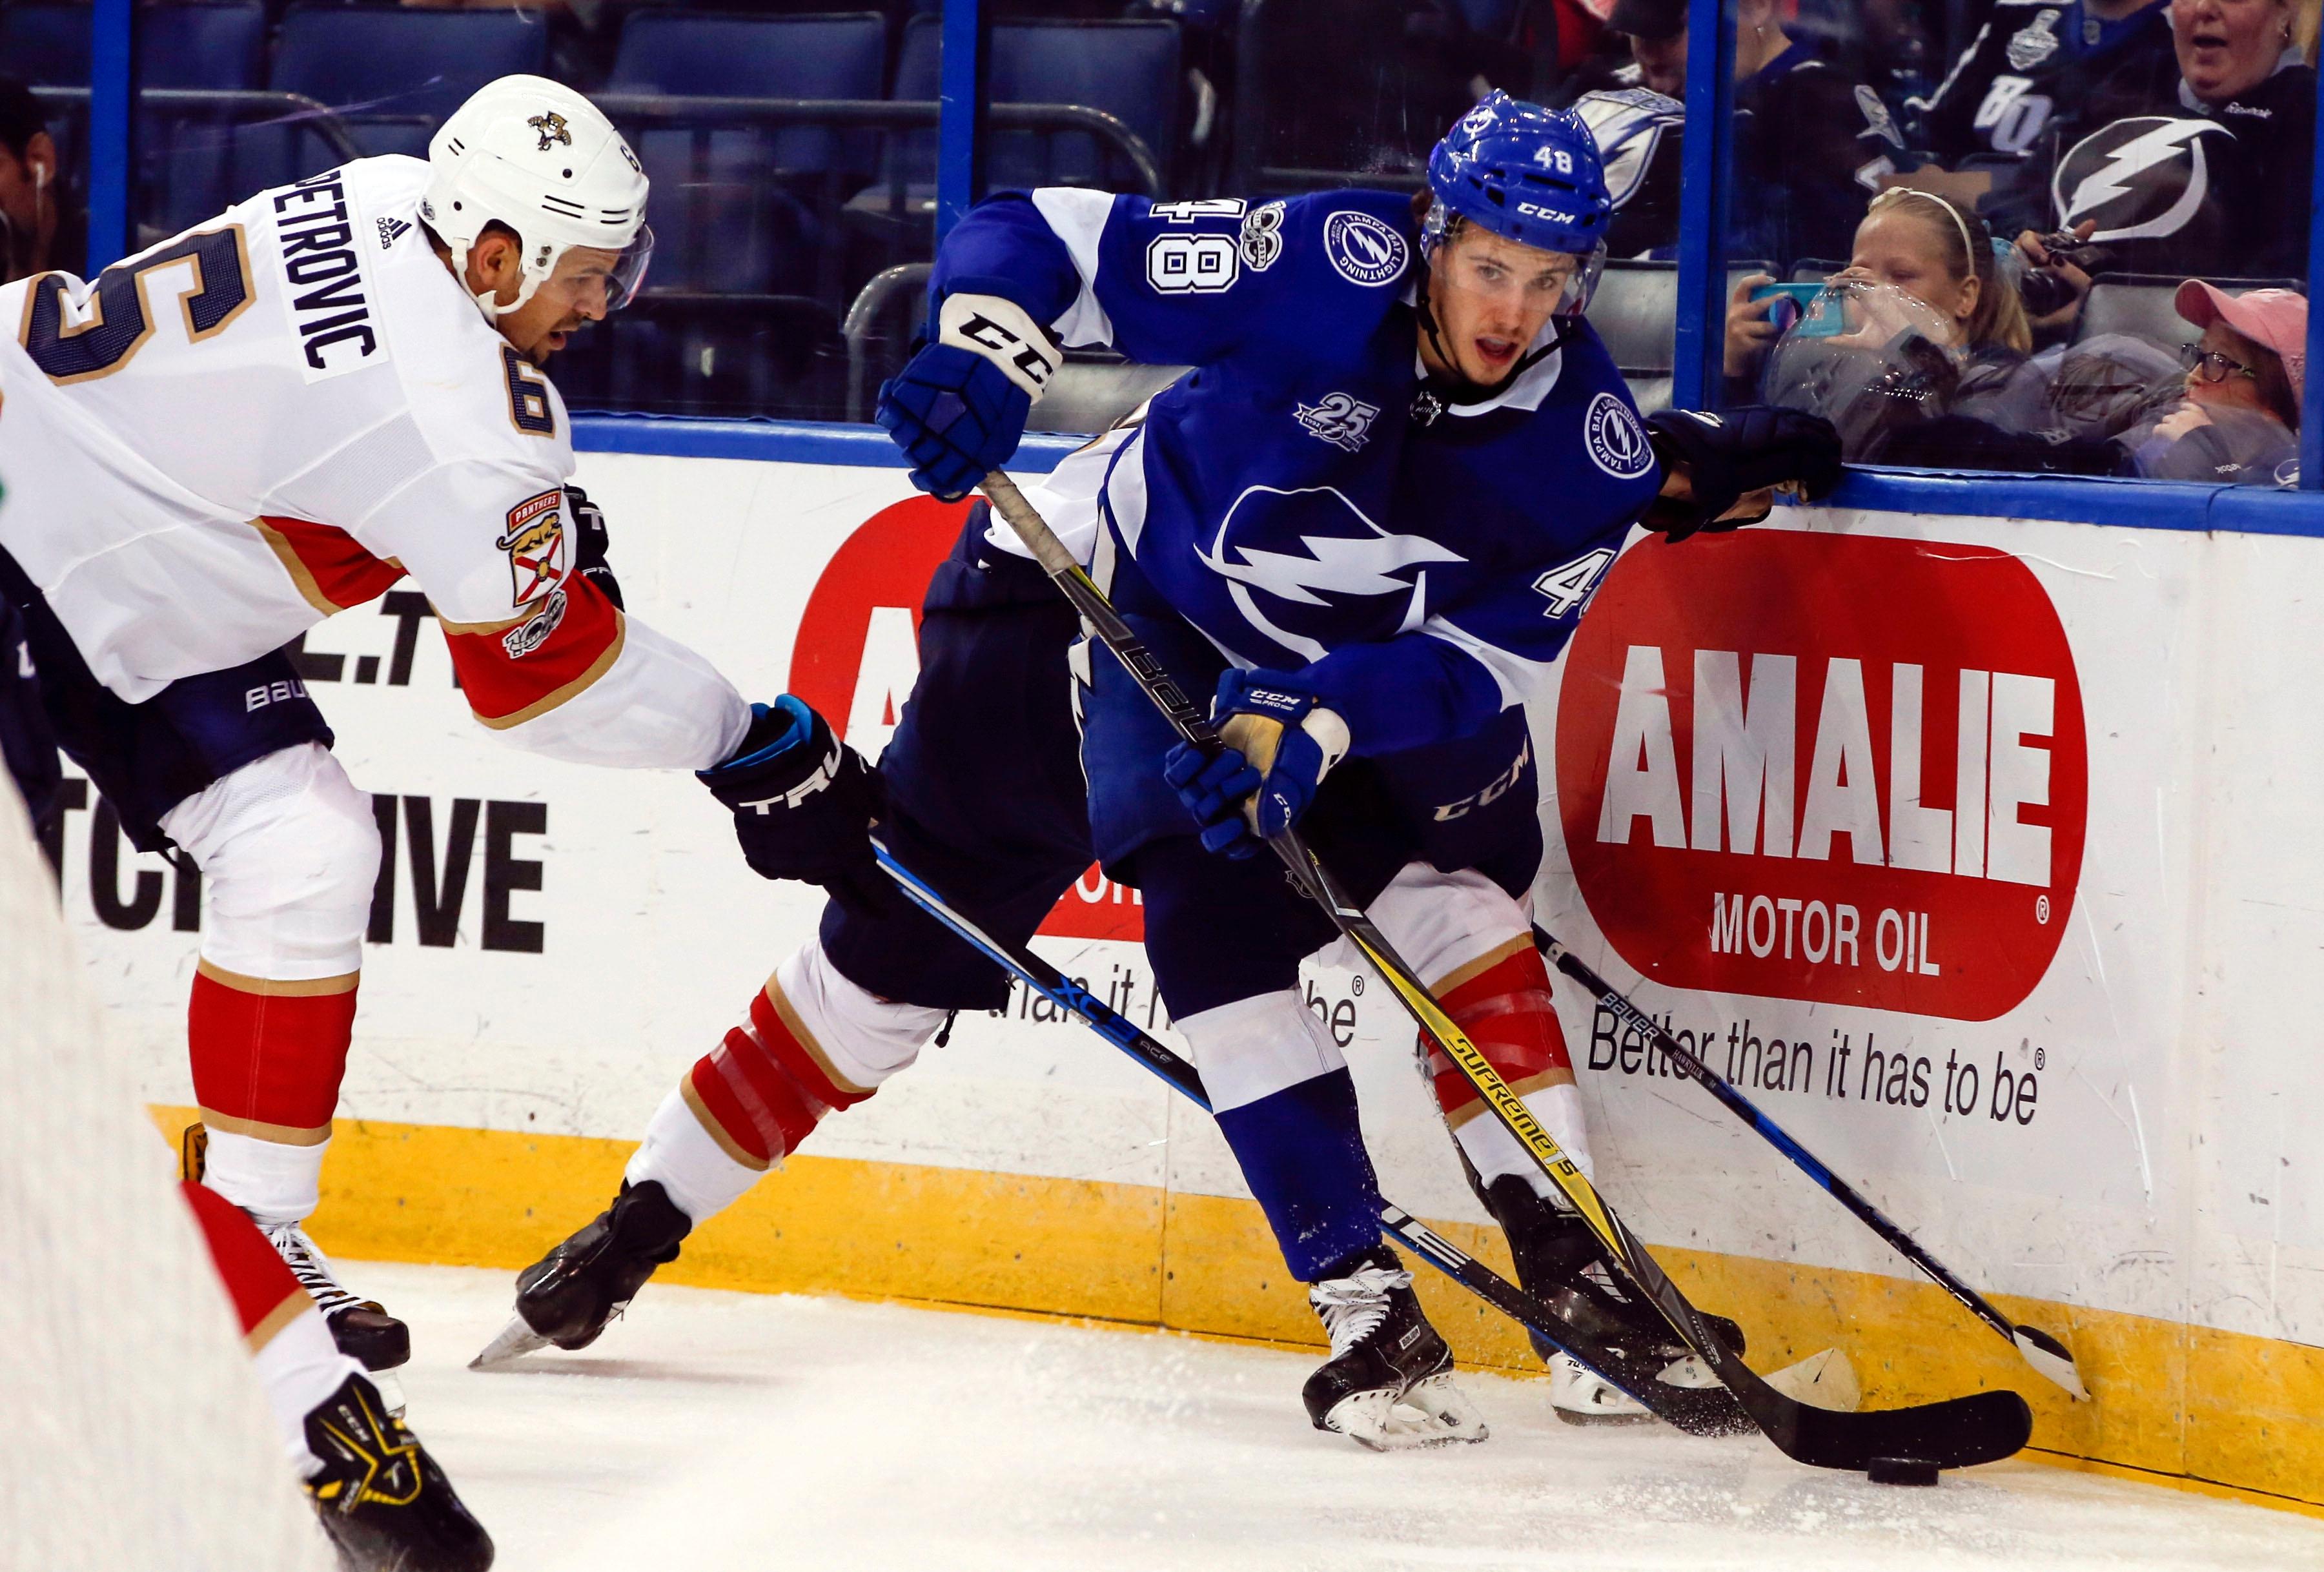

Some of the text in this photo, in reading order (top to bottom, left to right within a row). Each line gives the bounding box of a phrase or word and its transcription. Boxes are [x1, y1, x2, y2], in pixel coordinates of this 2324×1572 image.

[1973, 74, 2054, 152] 80
[1533, 146, 1573, 174] 48
[376, 217, 392, 250] adidas
[1518, 202, 1575, 224] CCM
[1340, 214, 1403, 280] TAMPA BAY LIGHTNING
[499, 342, 556, 440] 6
[1310, 392, 1380, 438] 25
[1591, 409, 1604, 431] BAY
[1594, 438, 1622, 471] TAMPA
[516, 495, 556, 522] PANTHERS
[1250, 689, 1301, 705] CCM
[1262, 700, 1281, 708] PRO
[1433, 733, 1529, 822] CCM
[1597, 645, 2055, 888] AMALIE
[1711, 892, 1939, 976] MOTOR OIL
[1109, 965, 1134, 1019] it
[1601, 992, 1659, 1037] BAUER
[1588, 1003, 1715, 1080] Better
[1726, 1019, 1813, 1094] than
[1826, 1028, 1851, 1098] it
[1861, 1032, 1932, 1108] has
[1944, 1048, 1979, 1116] to
[1672, 1048, 1705, 1080] HAWRYLUK
[1447, 1037, 1554, 1152] SUPREME
